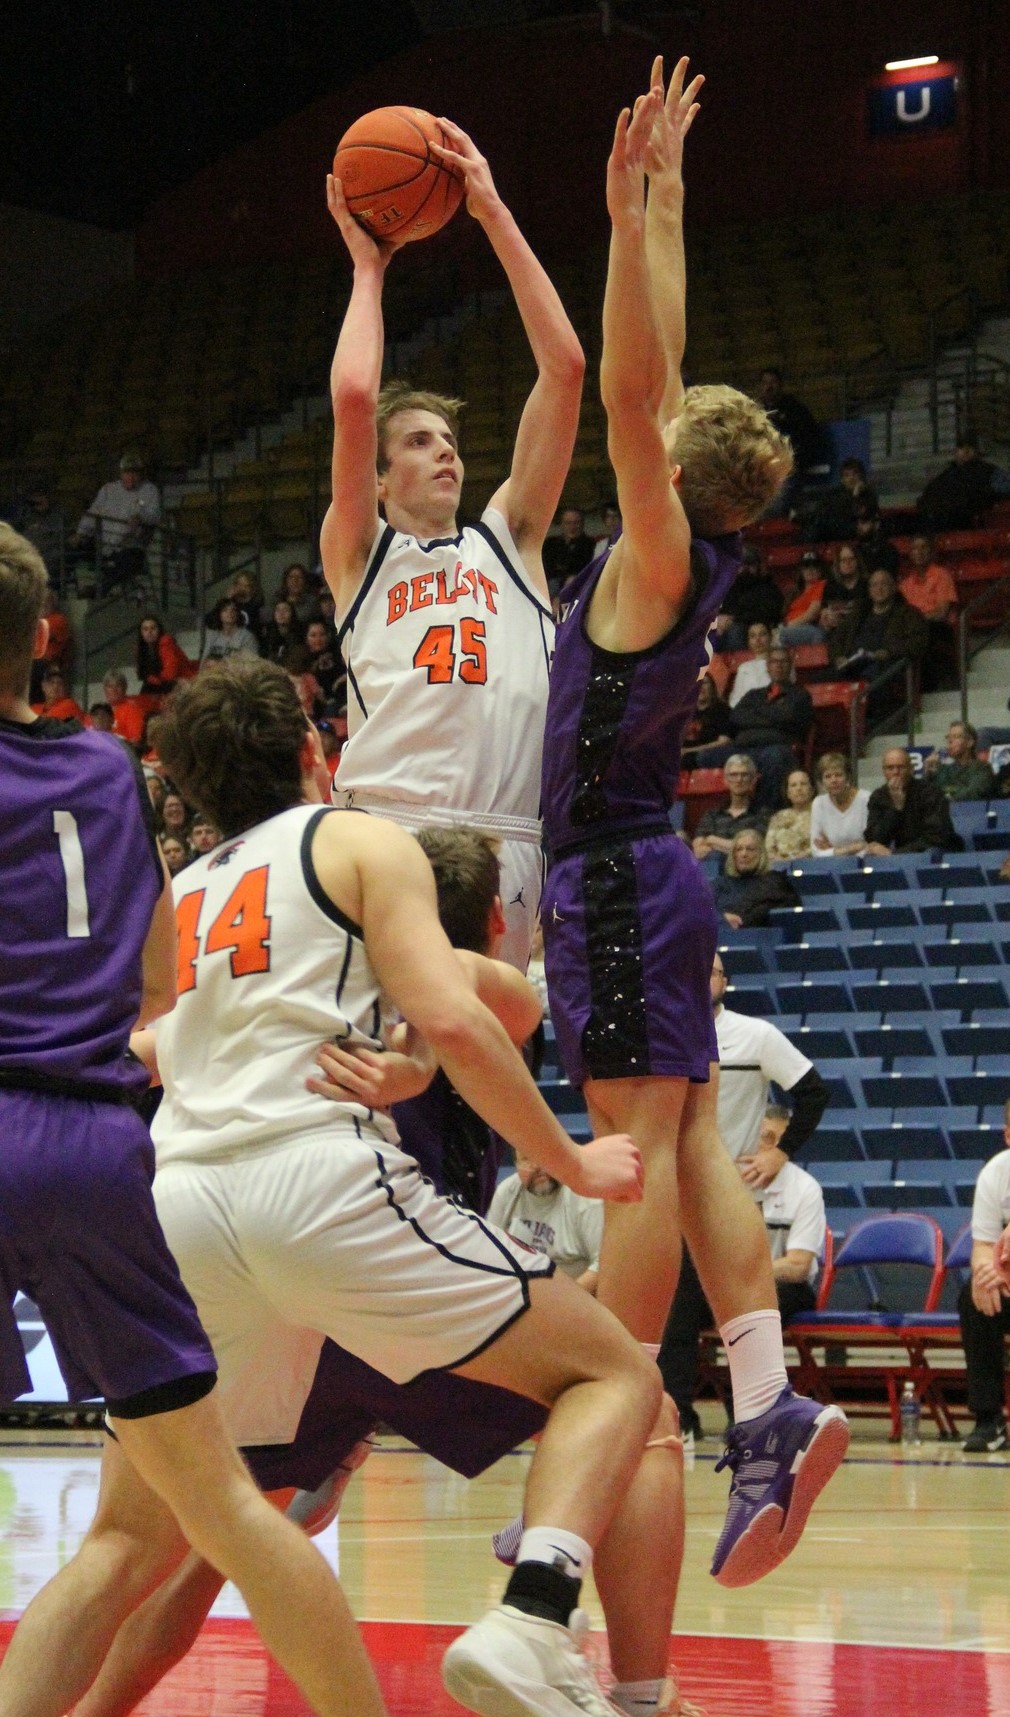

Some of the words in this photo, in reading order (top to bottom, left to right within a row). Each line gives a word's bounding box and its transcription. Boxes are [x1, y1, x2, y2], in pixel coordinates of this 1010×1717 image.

[896, 87, 931, 122] U
[413, 617, 488, 686] 45
[53, 810, 90, 937] 1
